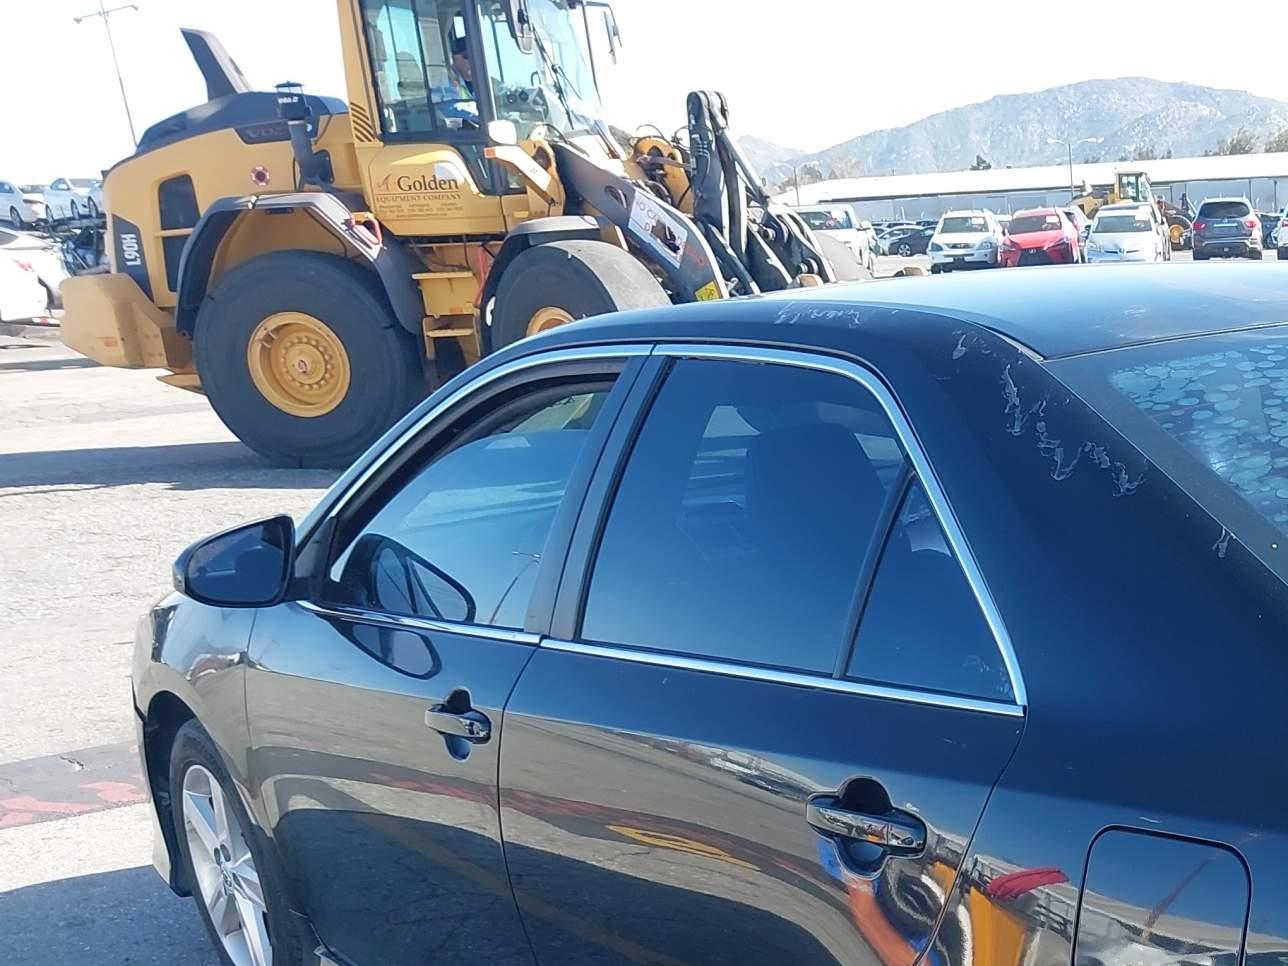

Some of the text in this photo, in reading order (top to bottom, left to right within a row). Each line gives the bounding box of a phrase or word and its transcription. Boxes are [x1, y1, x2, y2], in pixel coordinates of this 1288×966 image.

[397, 174, 459, 192] Golden
[375, 193, 461, 203] EQUIPMENT COMPANY
[120, 233, 141, 266] L90H
